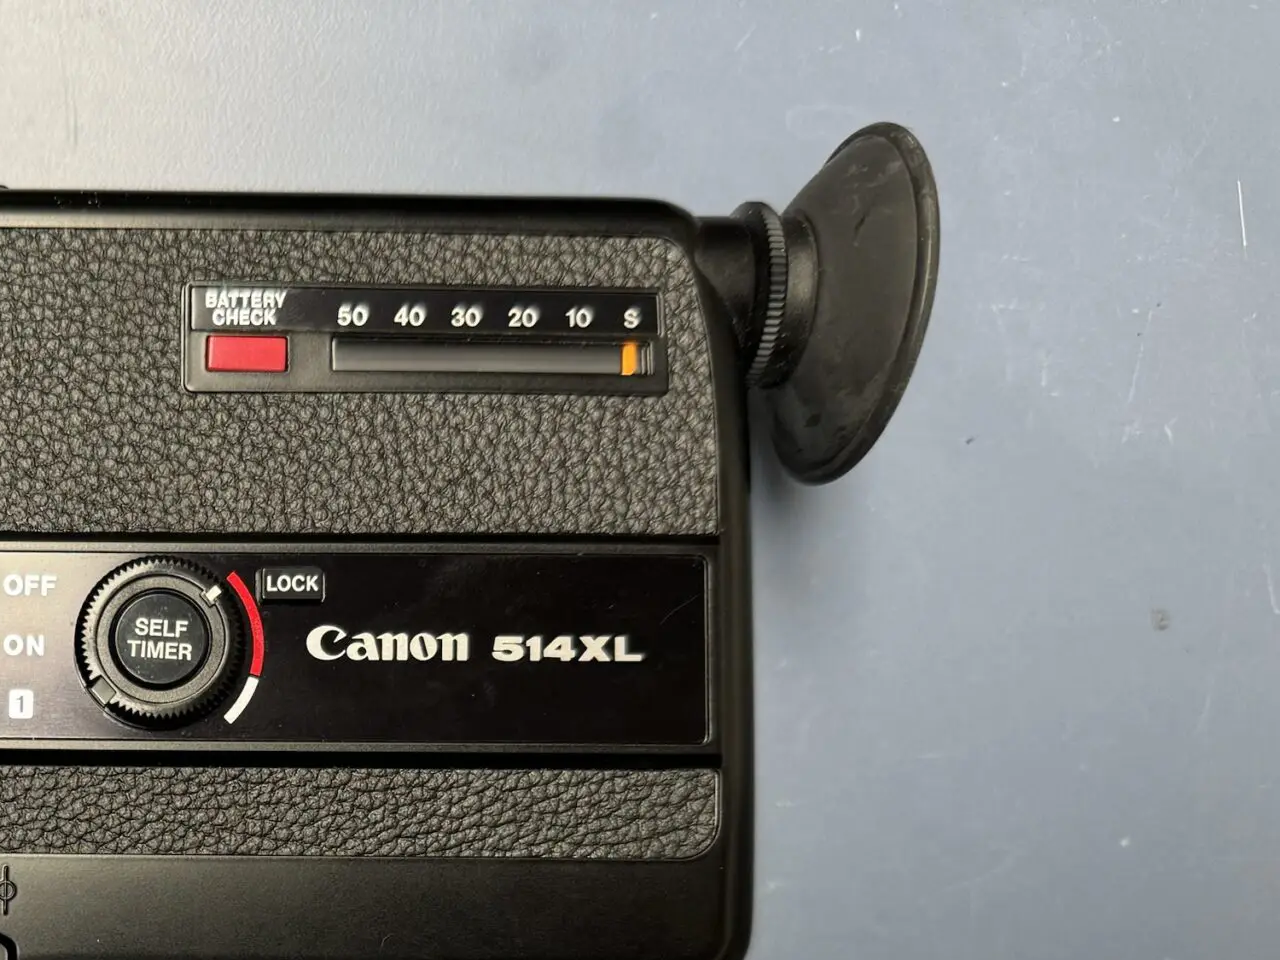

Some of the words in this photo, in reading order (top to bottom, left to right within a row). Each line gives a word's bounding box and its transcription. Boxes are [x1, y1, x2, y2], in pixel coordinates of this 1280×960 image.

[205, 287, 287, 309] BATTERY
[212, 308, 276, 326] CHECK
[337, 304, 369, 326] 50
[394, 305, 426, 327] 40
[451, 306, 483, 328] 30
[508, 307, 540, 328] 20
[565, 307, 594, 328] 10
[623, 308, 642, 329] S
[3, 574, 57, 597] OFF
[266, 575, 319, 593] LOCK
[134, 618, 188, 638] SELF
[3, 635, 45, 656] ON
[127, 640, 193, 661] TIMER
[306, 625, 469, 662] Canon
[492, 635, 644, 662] 514XL
